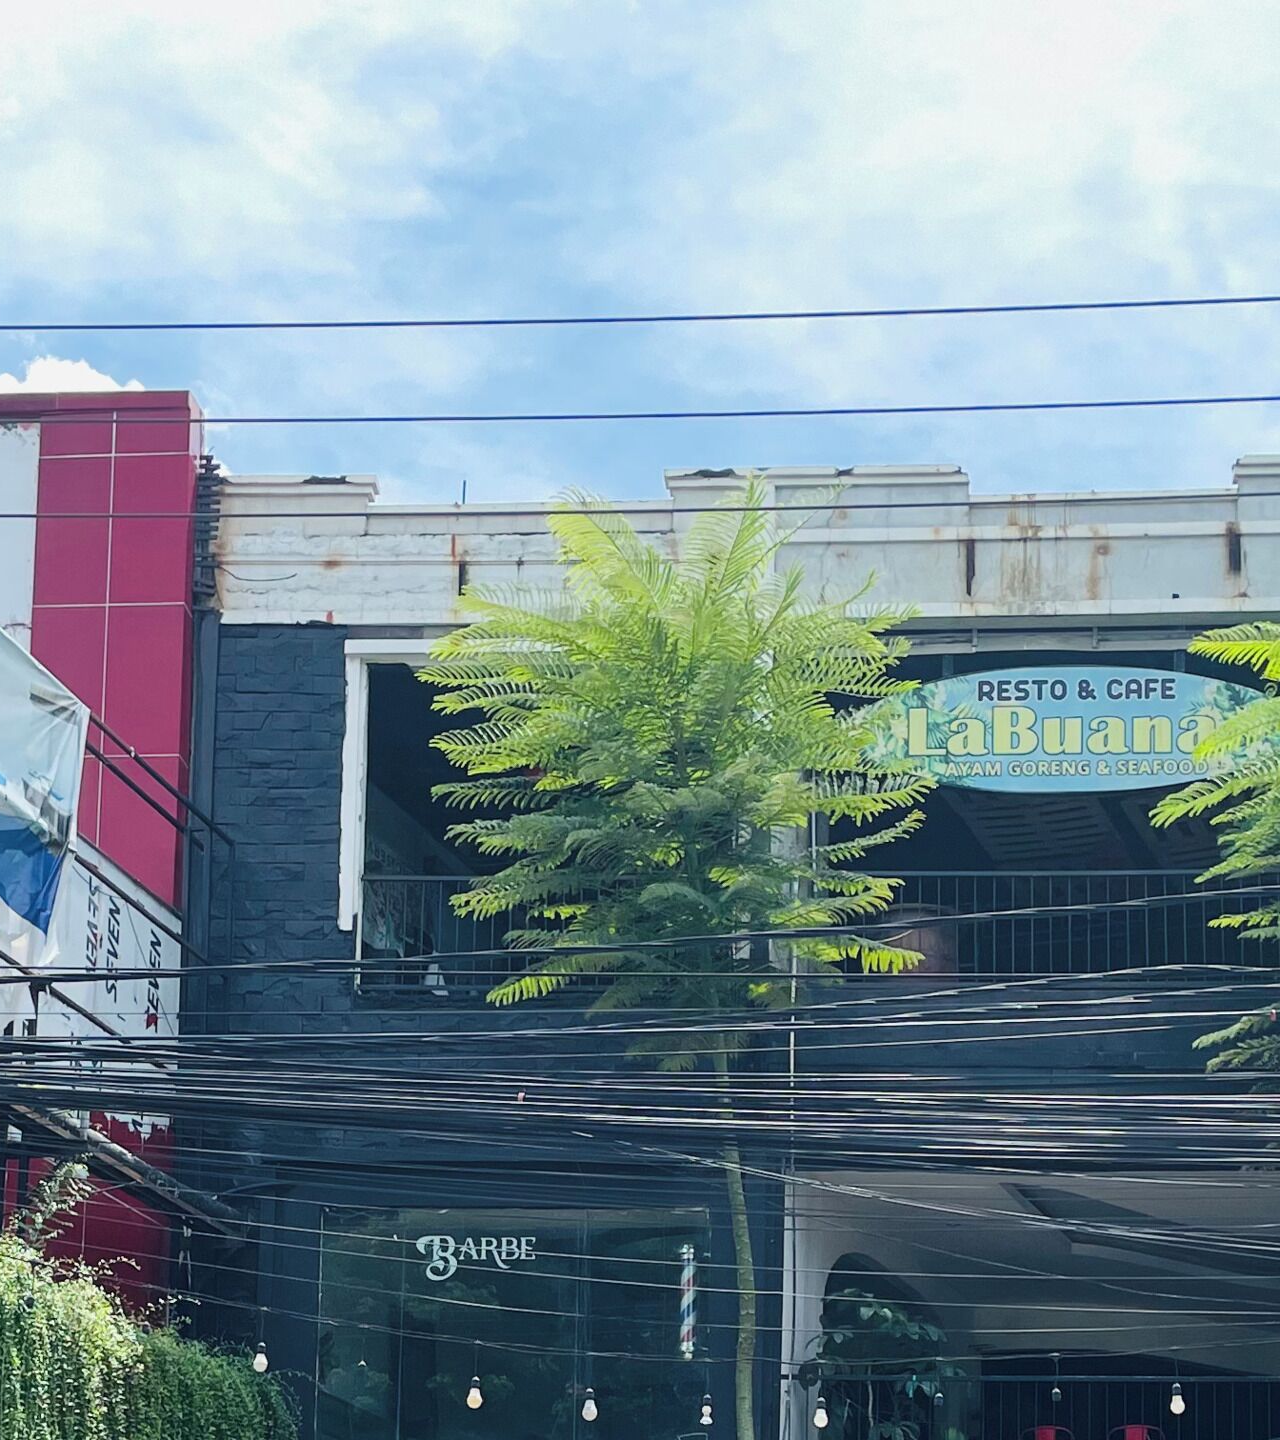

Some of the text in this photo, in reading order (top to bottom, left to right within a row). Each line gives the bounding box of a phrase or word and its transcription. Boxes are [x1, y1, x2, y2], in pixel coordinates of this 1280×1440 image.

[978, 677, 1176, 702] RESTO & CAFE
[907, 706, 1218, 757] LaBuana
[946, 759, 1208, 777] AYAM GORENG & SEAFOOD
